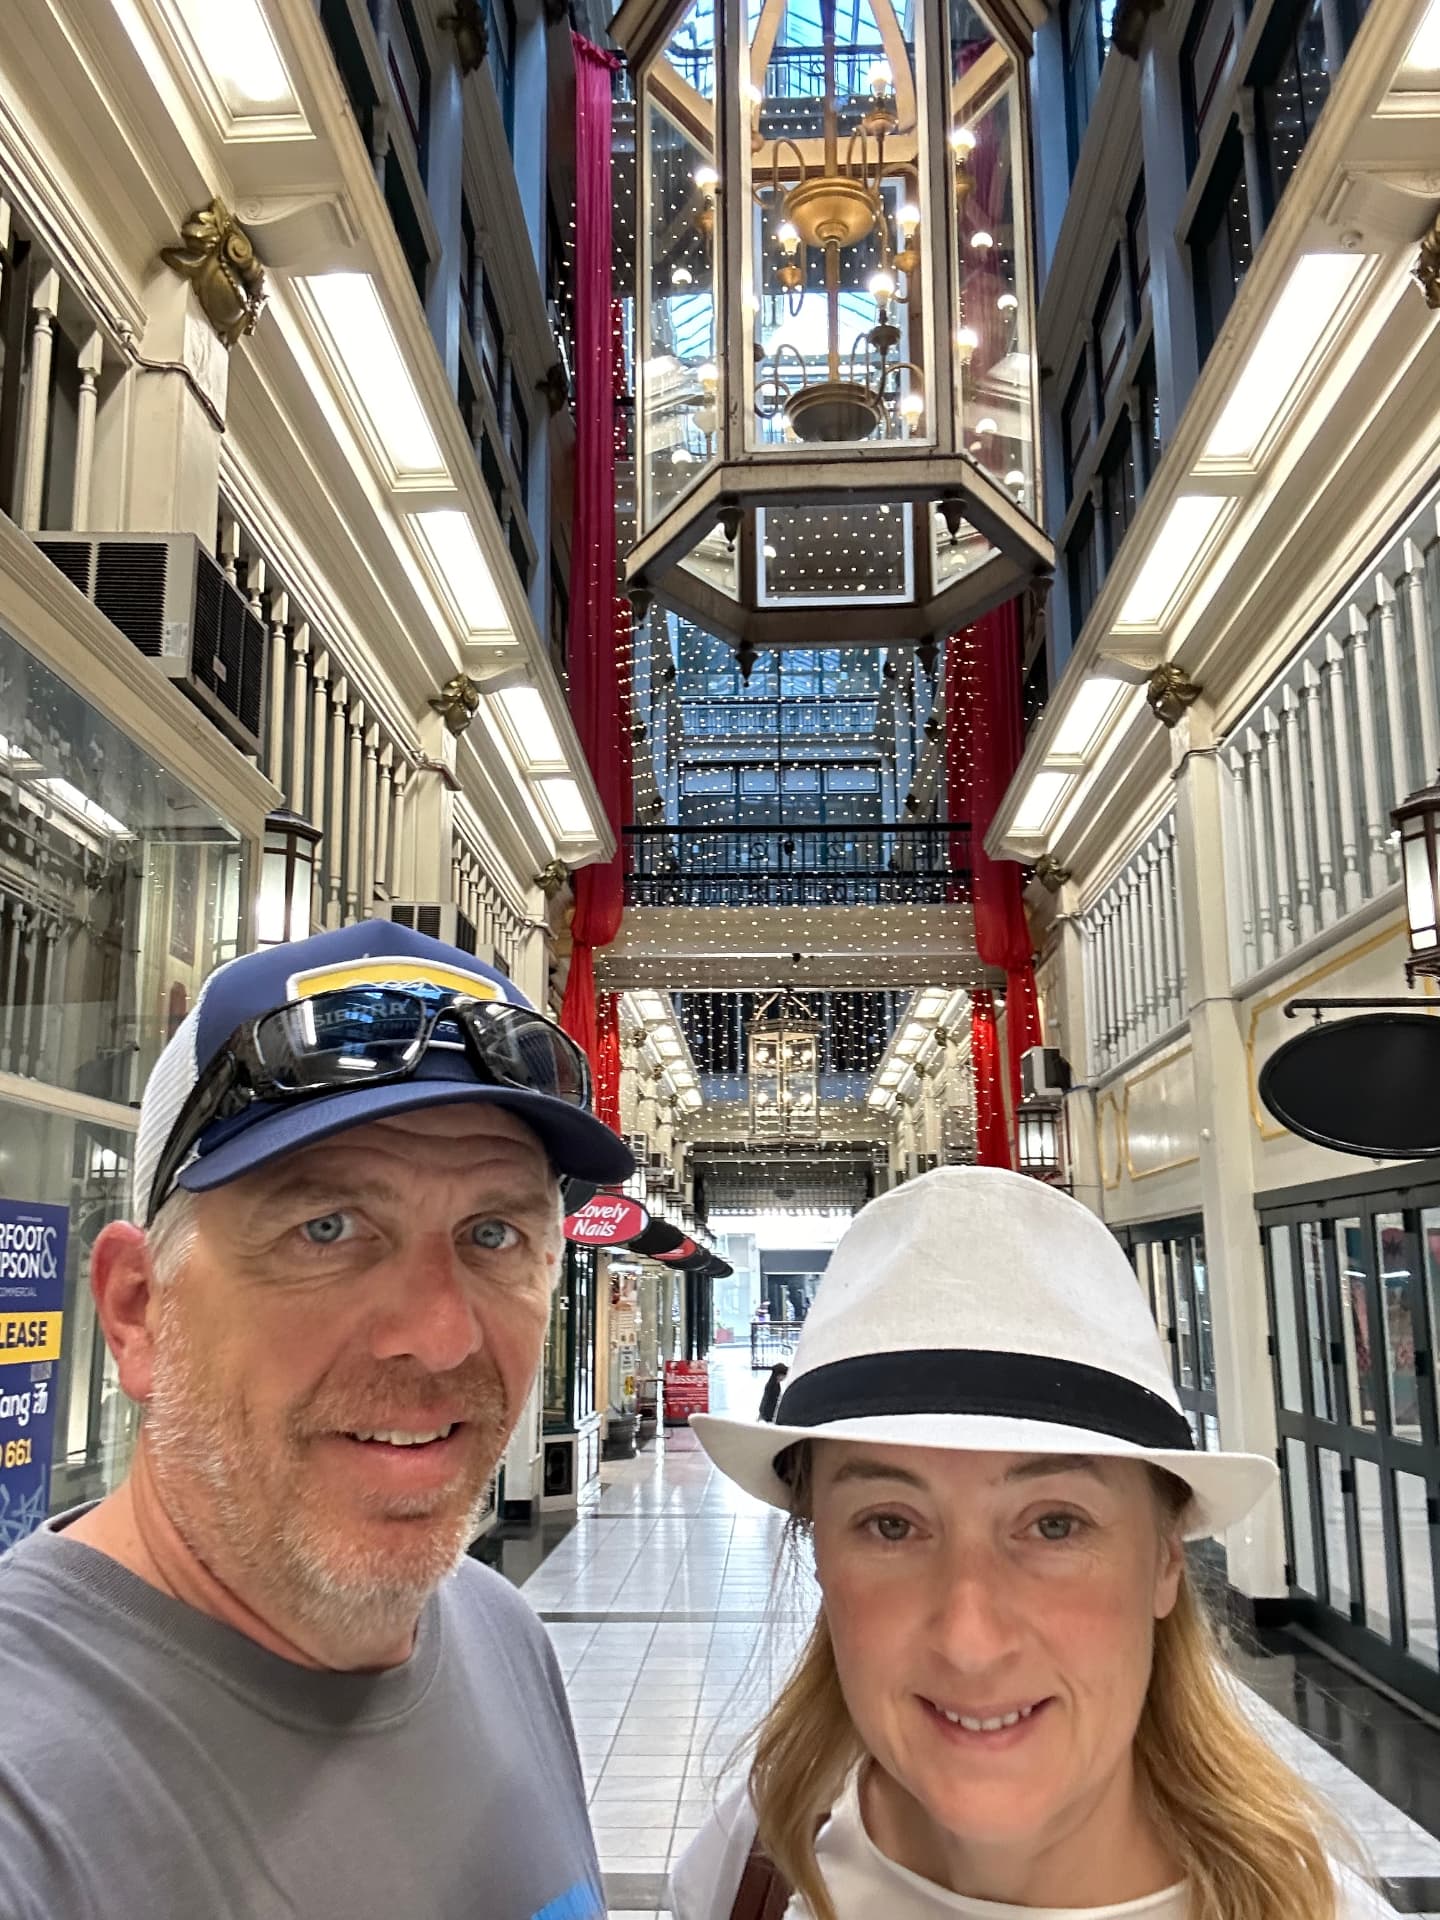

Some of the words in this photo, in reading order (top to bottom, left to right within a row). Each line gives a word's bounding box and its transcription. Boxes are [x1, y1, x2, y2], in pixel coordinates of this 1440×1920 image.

[573, 1201, 630, 1223] Lovely
[572, 1219, 617, 1237] Nails
[0, 1251, 40, 1278] PSON
[5, 1438, 32, 1468] 661
